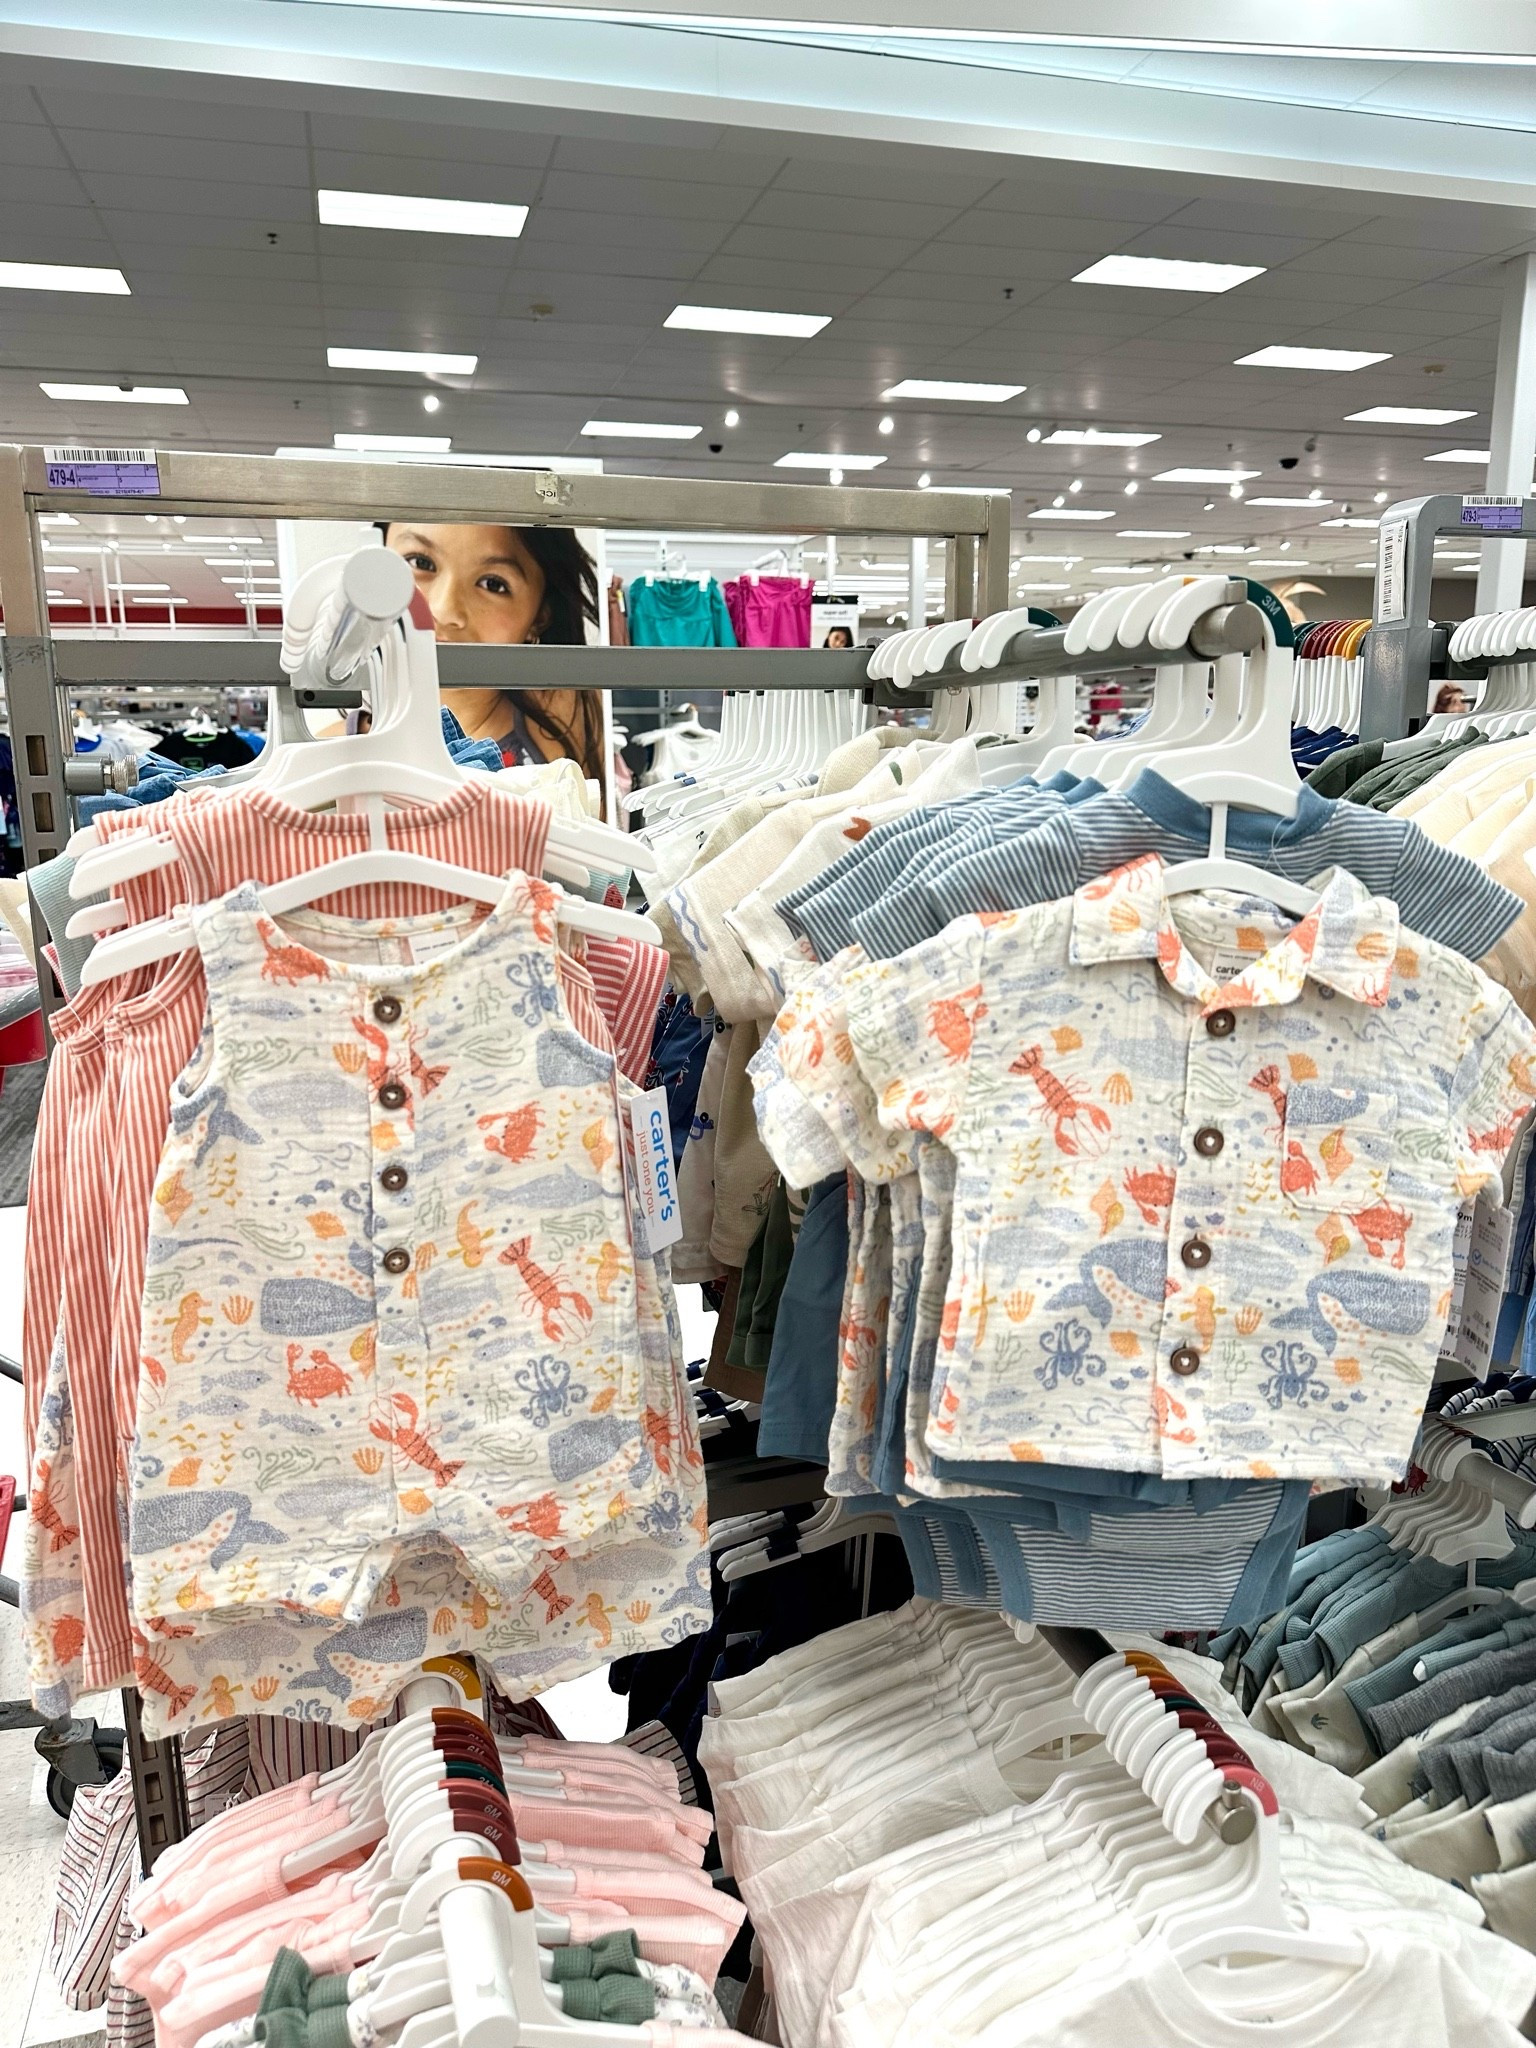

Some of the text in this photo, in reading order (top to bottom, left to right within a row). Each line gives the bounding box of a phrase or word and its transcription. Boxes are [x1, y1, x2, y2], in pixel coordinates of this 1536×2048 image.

[49, 469, 75, 485] 479-4
[1463, 510, 1477, 522] 479-3
[1262, 595, 1281, 617] 3M
[1216, 966, 1243, 975] carte
[636, 1130, 655, 1215] just one you
[650, 1110, 676, 1222] carter's
[449, 1664, 468, 1682] 12M
[1251, 1777, 1265, 1791] NB
[483, 1804, 501, 1820] 6M
[483, 1825, 501, 1841] 6M
[490, 1870, 513, 1888] 9M
